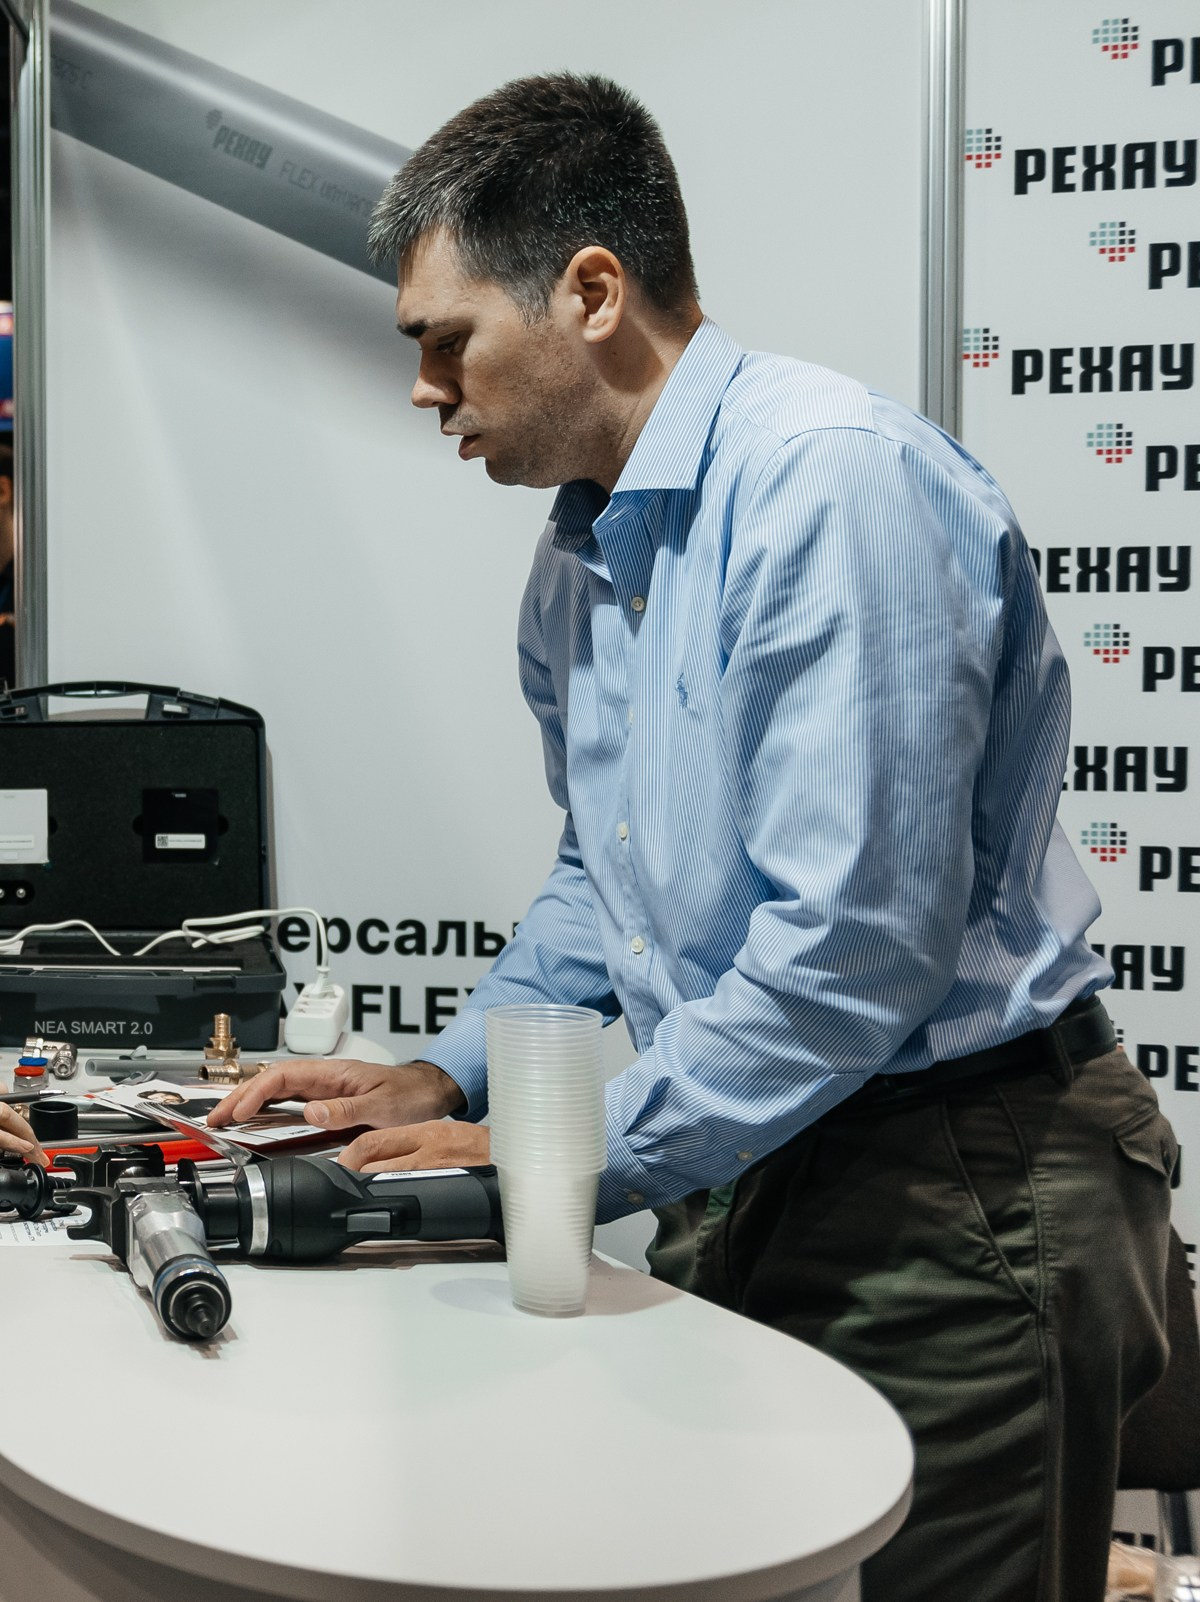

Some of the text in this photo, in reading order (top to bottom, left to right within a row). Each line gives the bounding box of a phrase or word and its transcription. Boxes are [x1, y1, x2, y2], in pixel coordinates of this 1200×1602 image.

[1014, 139, 1198, 196] РЕХАУ
[1011, 343, 1195, 396] РЕХАУ
[1029, 545, 1192, 593] ЕХАУ
[1062, 745, 1189, 793] ХАУ
[1139, 845, 1200, 893] РЕ
[277, 916, 520, 966] ерсаль
[1091, 944, 1186, 993] АУ
[34, 1021, 153, 1035] NEA SMART 2.0
[352, 984, 477, 1035] FLE
